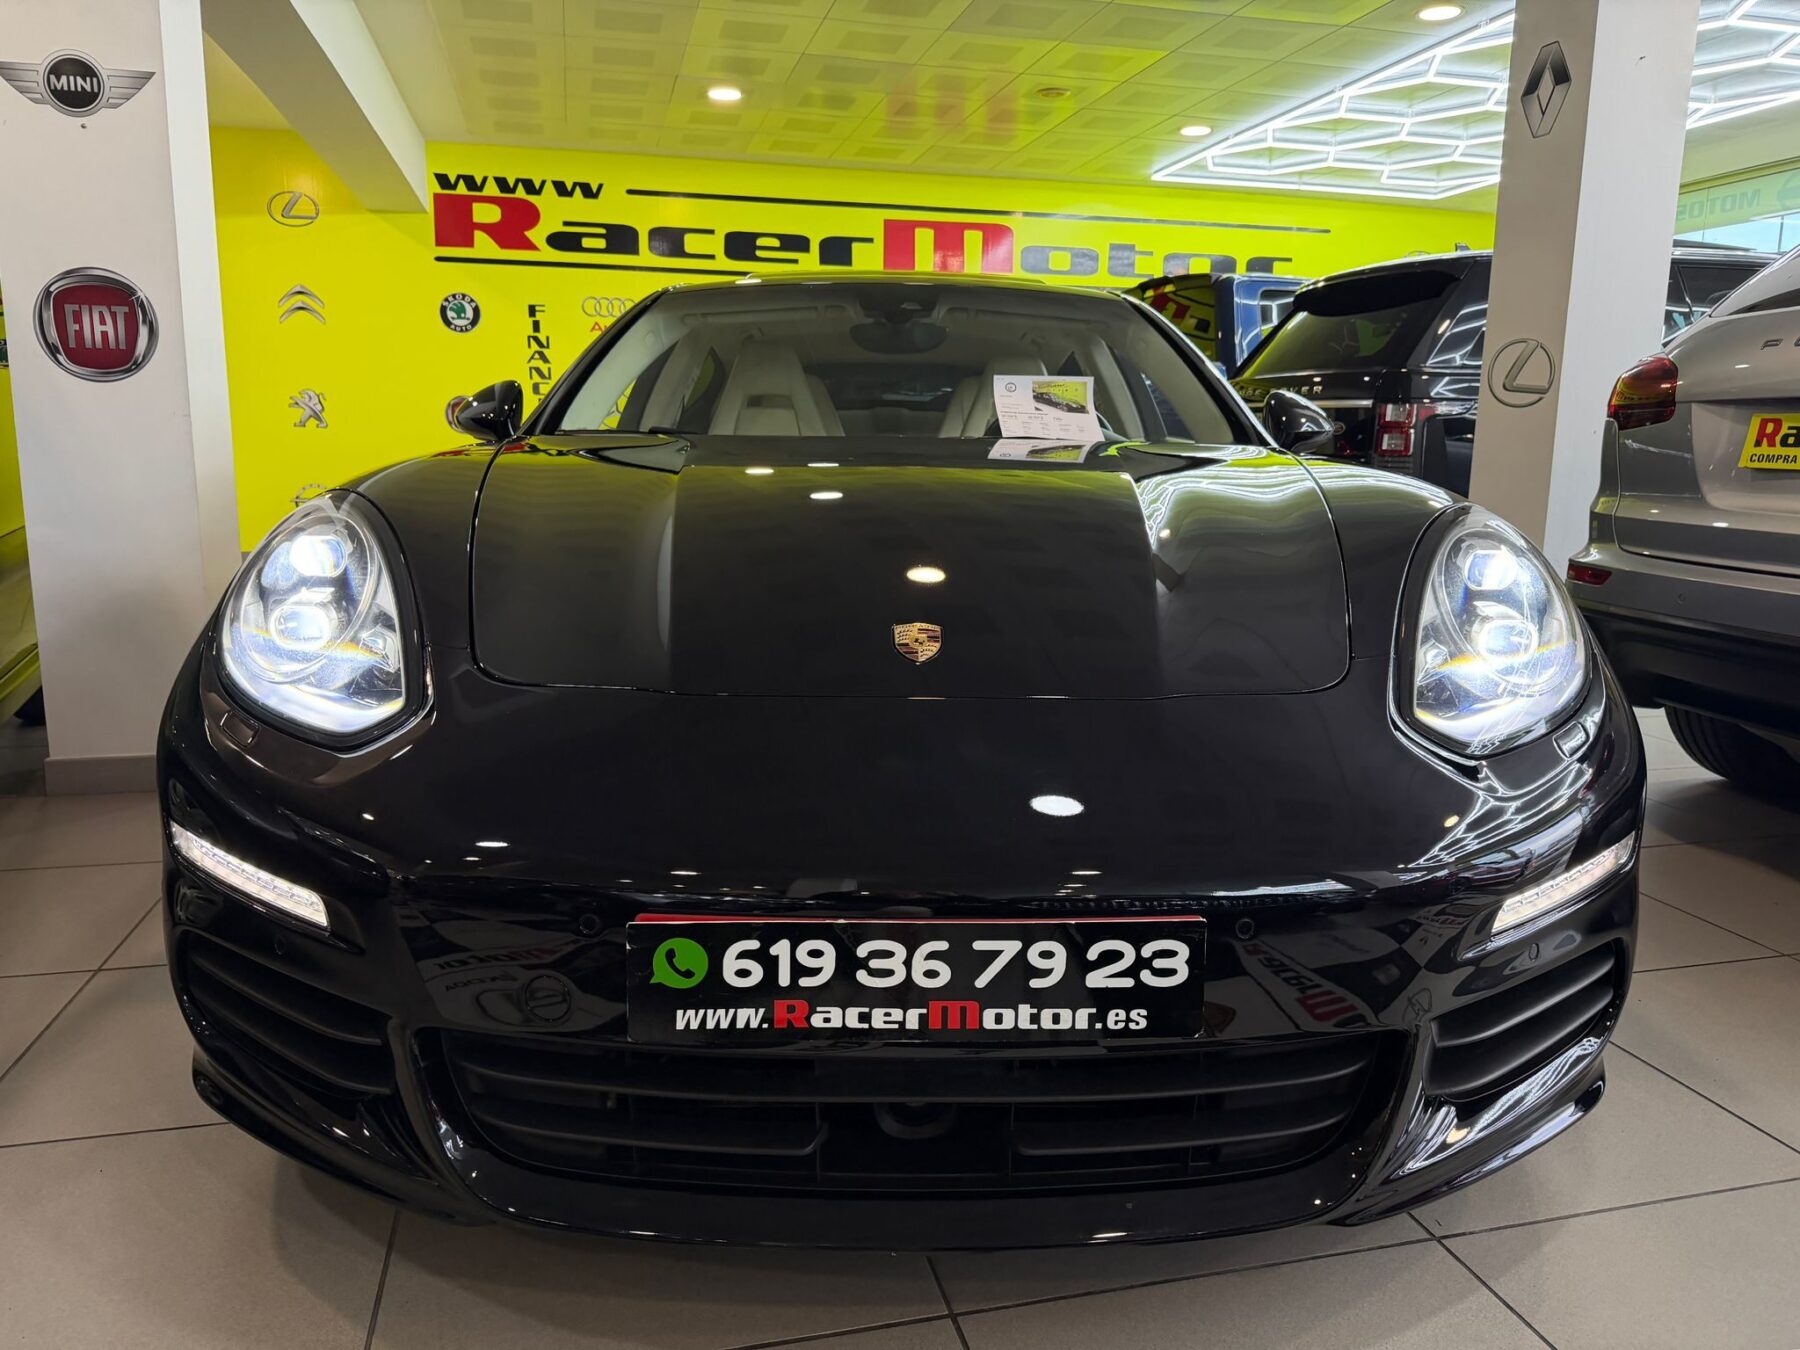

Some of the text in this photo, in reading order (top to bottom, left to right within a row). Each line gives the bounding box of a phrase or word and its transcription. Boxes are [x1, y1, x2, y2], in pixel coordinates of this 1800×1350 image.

[49, 74, 99, 93] MINI
[433, 172, 604, 199] www
[63, 303, 130, 350] FIAT
[1749, 453, 1798, 464] COMPRA
[722, 938, 1190, 989] 619 36 79 23
[675, 999, 1148, 1031] www.RacerMotor.es
